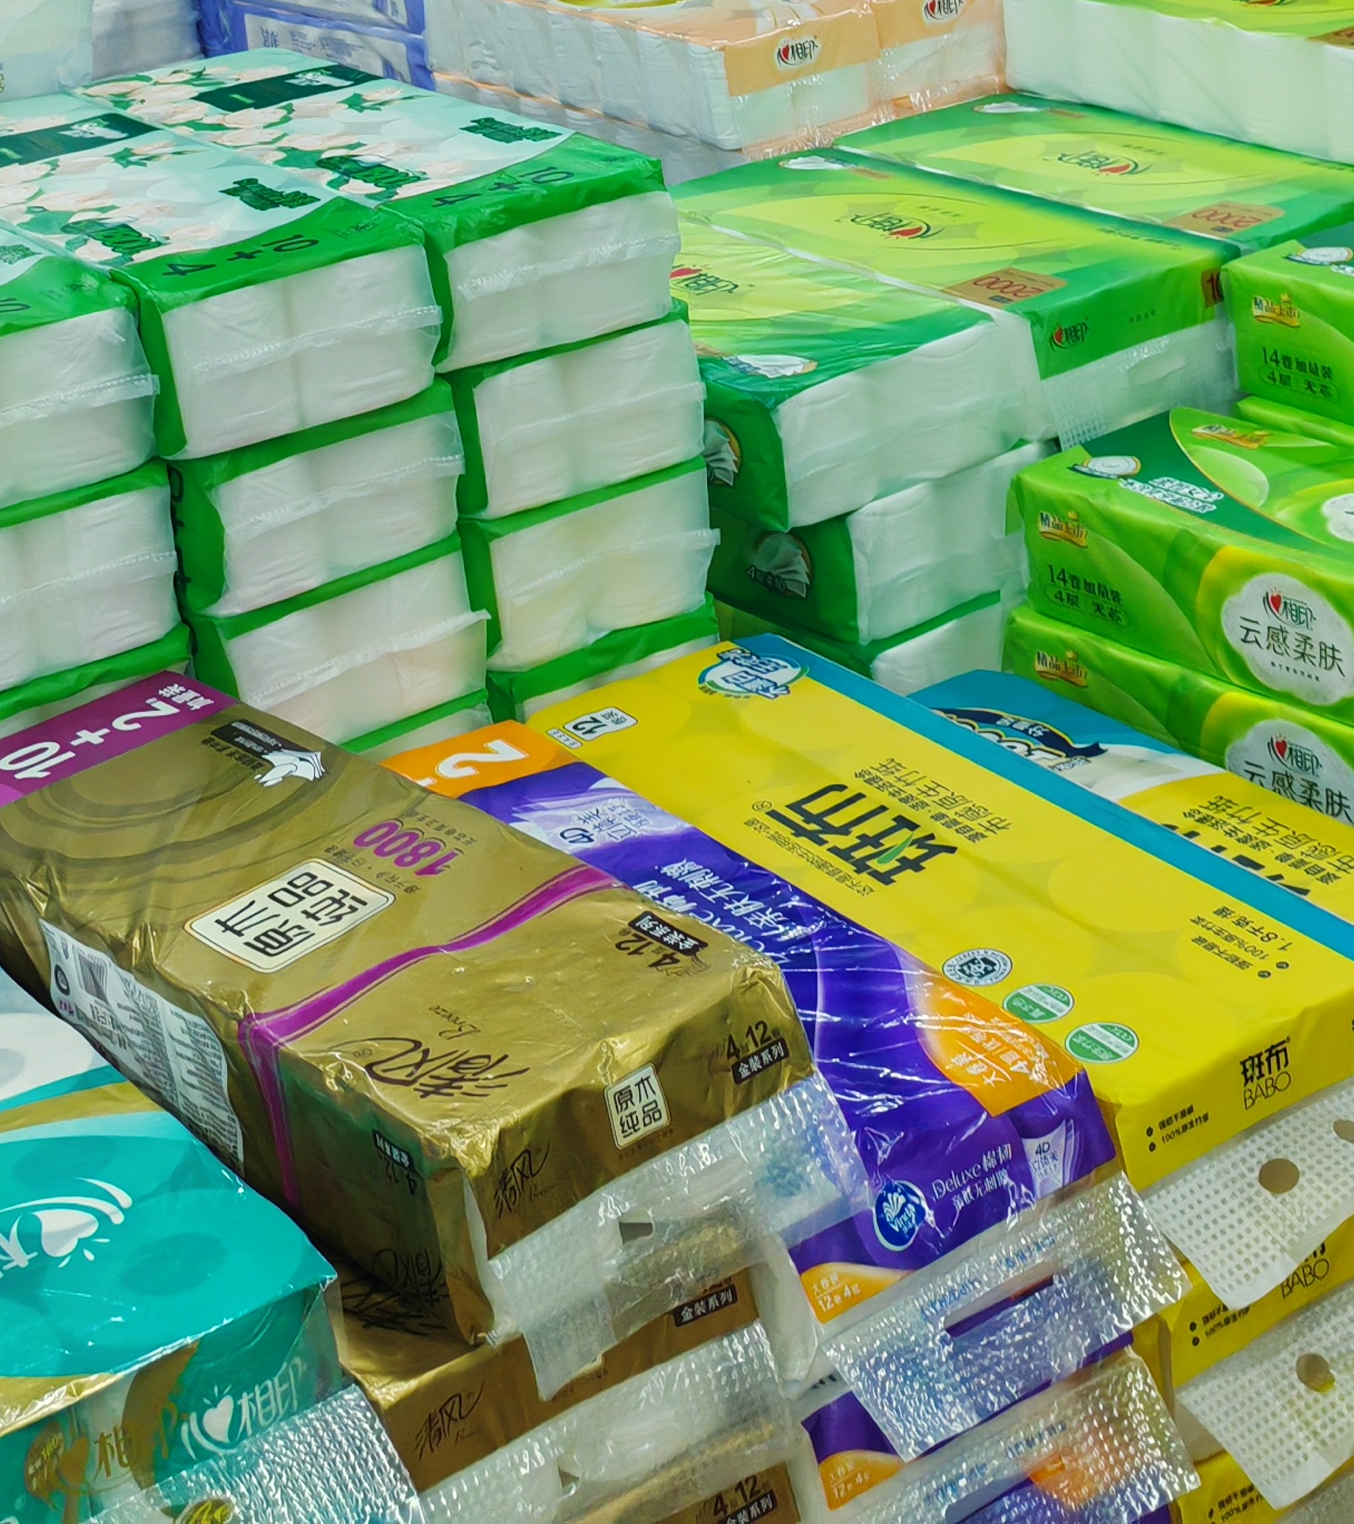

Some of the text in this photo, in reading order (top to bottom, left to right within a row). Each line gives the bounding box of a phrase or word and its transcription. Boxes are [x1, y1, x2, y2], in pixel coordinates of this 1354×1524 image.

[775, 35, 823, 70] 心相印
[1261, 584, 1317, 631] 心相印
[1237, 617, 1345, 678] 云感柔肤
[570, 716, 602, 740] 12
[1267, 732, 1323, 776] 心相印
[869, 757, 1013, 840] 布感原生竹纸
[352, 818, 465, 877] 1800
[767, 783, 959, 887] 斑布
[272, 867, 372, 940] 纯品
[212, 901, 319, 960] 原木
[736, 1042, 786, 1080] 金装系列
[1239, 1038, 1292, 1087] 斑布
[612, 1074, 658, 1116] 原木
[1243, 1070, 1293, 1111] BABO
[618, 1099, 663, 1140] 纯品
[1033, 1140, 1051, 1157] 4D
[931, 1160, 983, 1199] Deluxe
[1280, 1256, 1331, 1300] BABO
